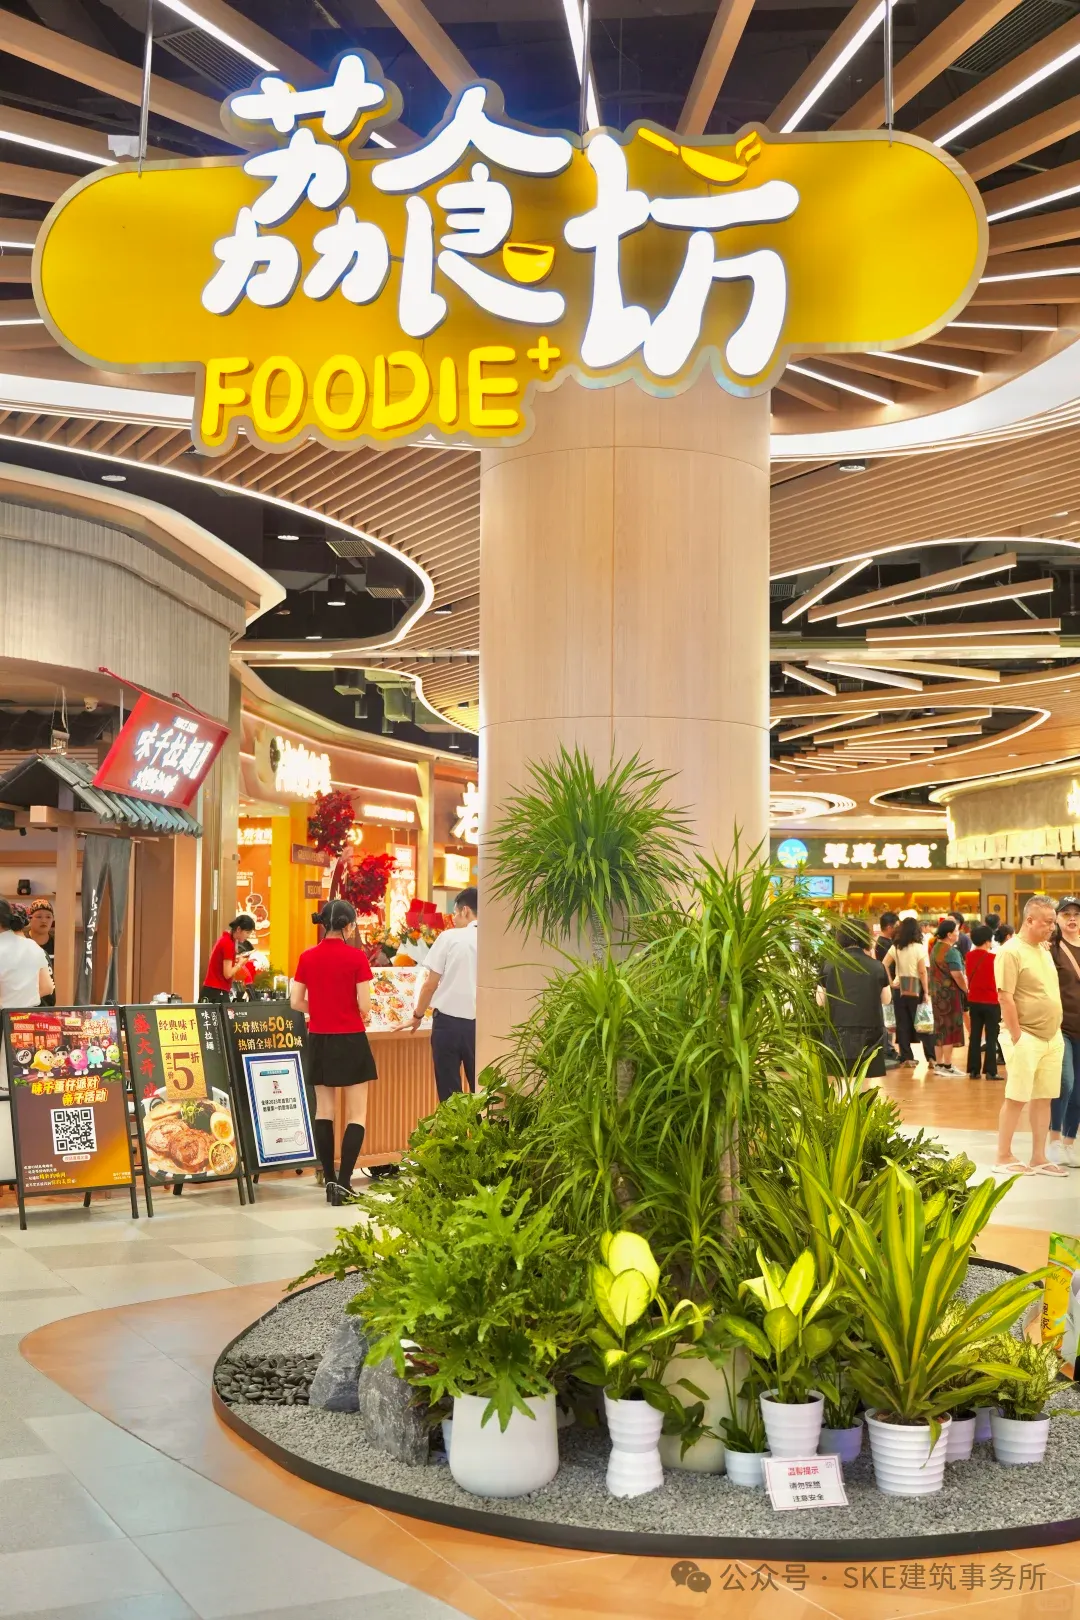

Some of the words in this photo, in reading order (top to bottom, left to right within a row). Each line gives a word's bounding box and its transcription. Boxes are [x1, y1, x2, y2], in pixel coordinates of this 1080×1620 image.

[202, 53, 801, 377] 荔食坊
[158, 1019, 196, 1031] 经典味千
[788, 1465, 819, 1476] 温馨提示
[793, 1493, 824, 1502] 注意安全
